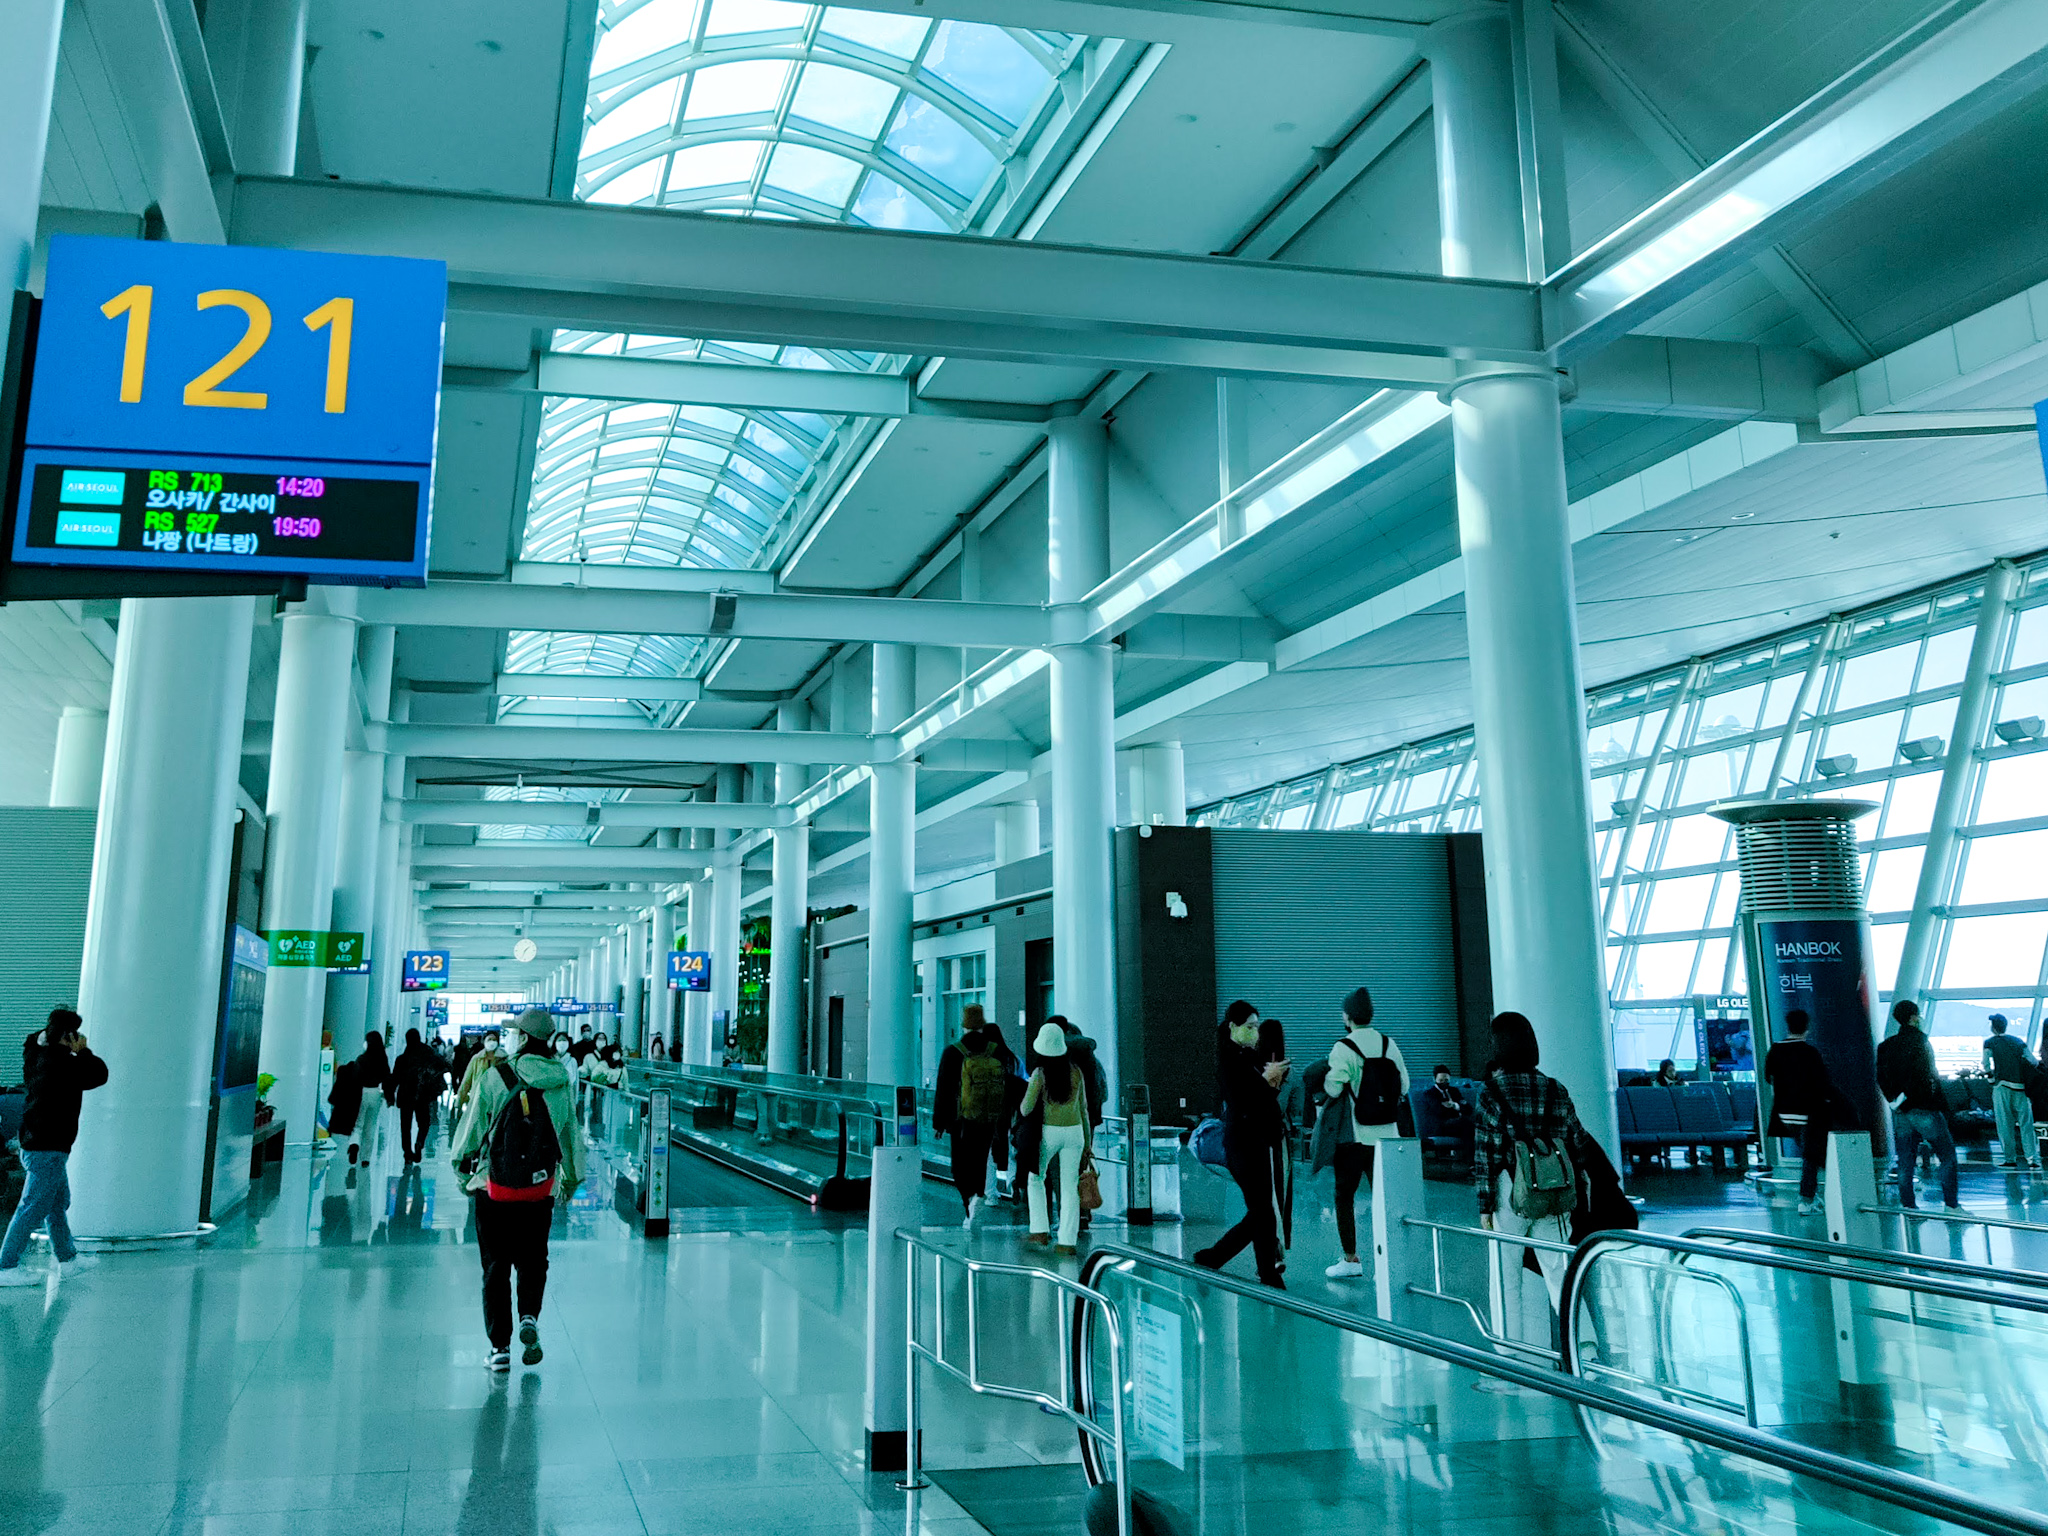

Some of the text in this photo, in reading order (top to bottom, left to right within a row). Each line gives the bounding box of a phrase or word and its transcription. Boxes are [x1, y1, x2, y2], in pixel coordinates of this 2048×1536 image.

[100, 285, 354, 413] 121
[67, 483, 119, 493] AIR SEOUL
[149, 470, 223, 494] RS 713
[276, 476, 325, 498] 14:20
[145, 489, 275, 514] 오사카/ 간사이
[62, 524, 114, 534] AIR SEOUL
[144, 510, 220, 534] RS 527
[273, 516, 322, 538] 19:50
[186, 532, 258, 555] (나트랑)
[295, 940, 316, 950] AED
[1775, 941, 1842, 957] HANBOK
[335, 954, 352, 962] AED
[411, 955, 444, 972] 123
[672, 956, 703, 972] 124
[1778, 973, 1814, 993] 한복
[430, 999, 447, 1008] 125
[1716, 998, 1749, 1008] LG OLE
